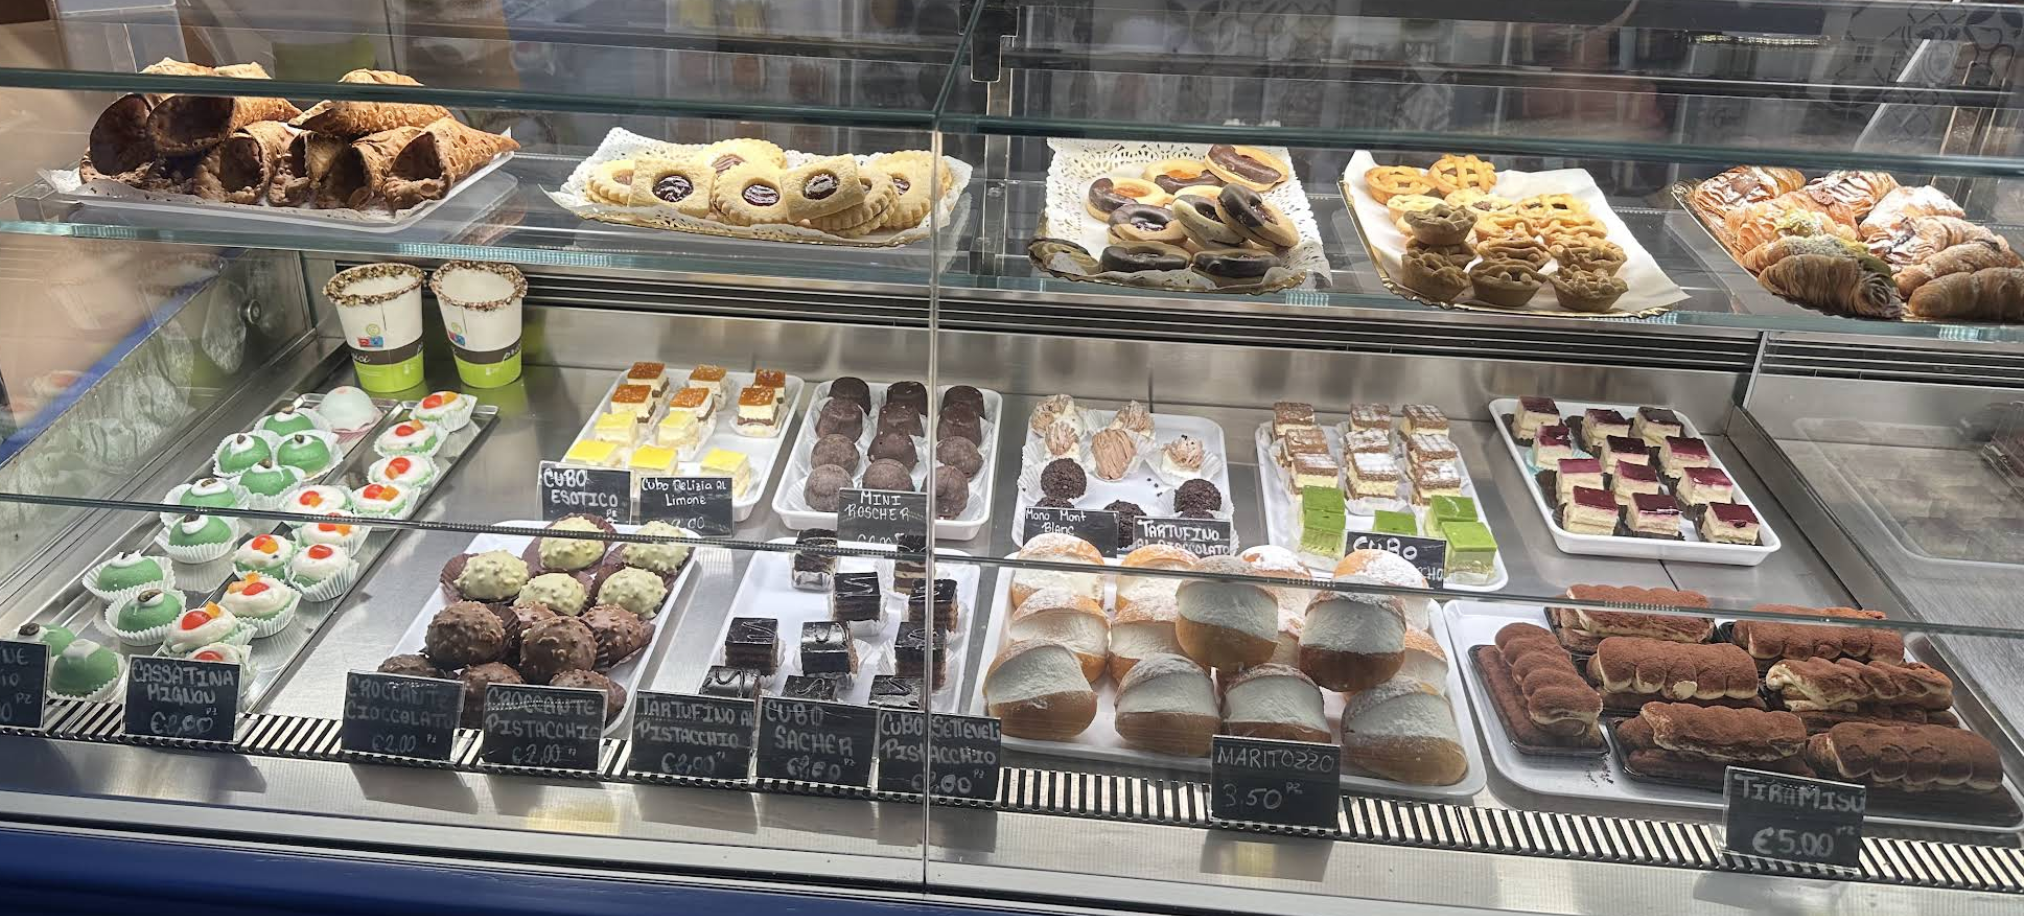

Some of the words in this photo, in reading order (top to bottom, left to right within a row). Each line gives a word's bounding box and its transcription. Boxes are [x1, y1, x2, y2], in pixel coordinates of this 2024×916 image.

[543, 467, 587, 488] CUBO
[551, 489, 618, 508] ESOTICO
[665, 493, 707, 507] Limone
[860, 491, 901, 506] MINI
[844, 503, 910, 522] ROSCHER
[1025, 507, 1050, 520] Mono
[1060, 509, 1087, 522] Mont
[1137, 519, 1220, 541] TARTUFINO
[132, 659, 234, 686] CASSATINA
[147, 683, 216, 705] MIGNON
[486, 686, 597, 715] CROCCANTE
[346, 700, 454, 729] CIOCCOLATO
[637, 695, 736, 725] TARTUFINO
[766, 699, 824, 726] CUBO
[485, 713, 600, 739] PISTACCHIO
[634, 720, 739, 748] PISTACCHIO
[775, 725, 853, 757] SACHER
[880, 738, 996, 765] PISTACCHIO
[1217, 746, 1334, 773] MARITOZZO
